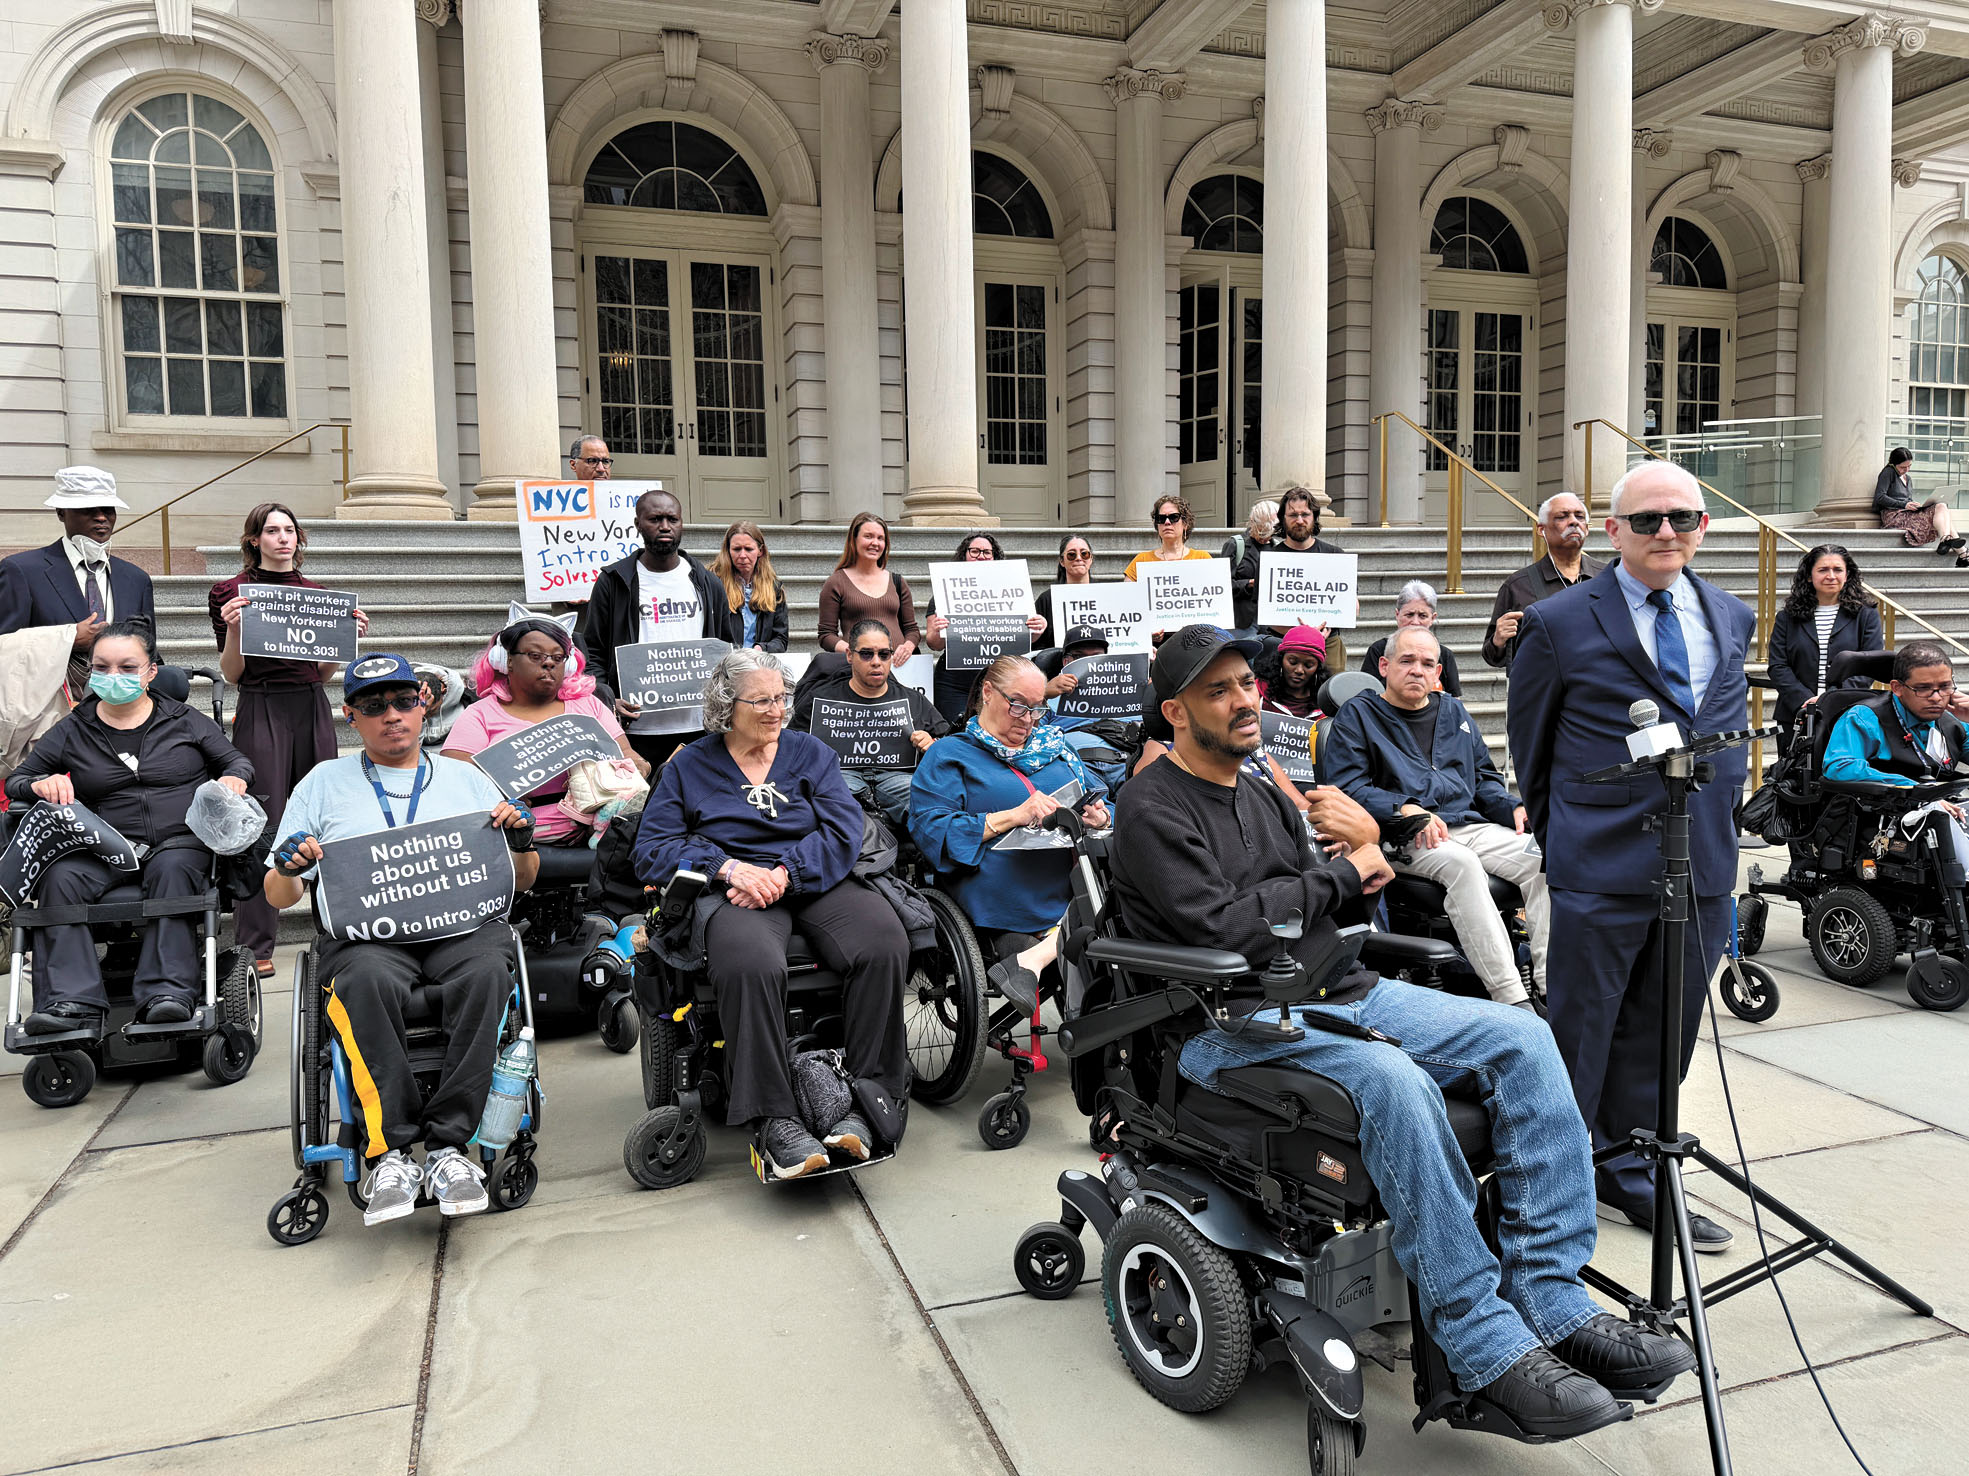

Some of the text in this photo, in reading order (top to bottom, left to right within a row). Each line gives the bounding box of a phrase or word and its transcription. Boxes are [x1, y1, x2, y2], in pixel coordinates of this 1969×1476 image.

[533, 488, 588, 514] NYC
[609, 491, 621, 508] is
[544, 520, 641, 545] New Yor
[538, 543, 640, 568] Intro 30
[540, 569, 598, 591] Solves
[1278, 568, 1304, 578] THE
[949, 578, 977, 588] THE
[1154, 576, 1180, 585] THE
[1278, 581, 1348, 592] LEGAL AID
[249, 589, 350, 606] Don't pit workers
[952, 588, 1024, 600] LEGAL AID
[1155, 586, 1224, 598] LEGAL AID
[1277, 594, 1336, 604] SOCIETY
[252, 602, 347, 617] against disabled
[640, 597, 698, 624] cidny
[954, 601, 1014, 613] SOCIETY
[1070, 601, 1096, 611] THE
[1156, 599, 1213, 610] SOCIETY
[261, 613, 337, 628] New Yorkers!
[976, 618, 987, 626] pit
[1071, 613, 1142, 625] LEGAL AID
[287, 628, 316, 644] NO
[264, 642, 338, 657] to Intro. 303!
[648, 647, 702, 660] Nothing
[980, 644, 1001, 656] NO
[647, 660, 707, 673] about us
[963, 657, 972, 665] to
[1088, 662, 1131, 673] Nothing
[639, 668, 715, 685] without us
[1087, 675, 1119, 685] about
[1079, 684, 1137, 696] without us!
[629, 690, 659, 705] NO
[662, 694, 673, 703] to
[821, 705, 906, 719] Don't pit workers
[1064, 701, 1089, 713] NO
[1091, 706, 1100, 714] to
[1102, 706, 1125, 714] Intro.
[823, 716, 908, 728] against disabled
[509, 720, 574, 750] Nothing
[831, 729, 902, 738] New Yorkers!
[1279, 722, 1310, 737] Noth
[516, 726, 584, 759] about us
[853, 741, 881, 754] NO
[1274, 734, 1309, 749] about
[513, 732, 598, 771] without us!
[1265, 744, 1310, 760] without
[843, 756, 874, 764] Intro.
[877, 754, 900, 764] 303!
[509, 769, 546, 792] NO
[548, 762, 563, 772] to
[16, 807, 77, 848] Nothing
[62, 822, 85, 832] us
[371, 832, 463, 863] Nothing
[19, 849, 56, 898] NO to
[371, 851, 472, 885] about us
[360, 864, 488, 909] without us!
[346, 895, 506, 941] NO to Intro. 303!
[1321, 1155, 1333, 1166] JAY
[1335, 1284, 1374, 1309] QUICKIE
